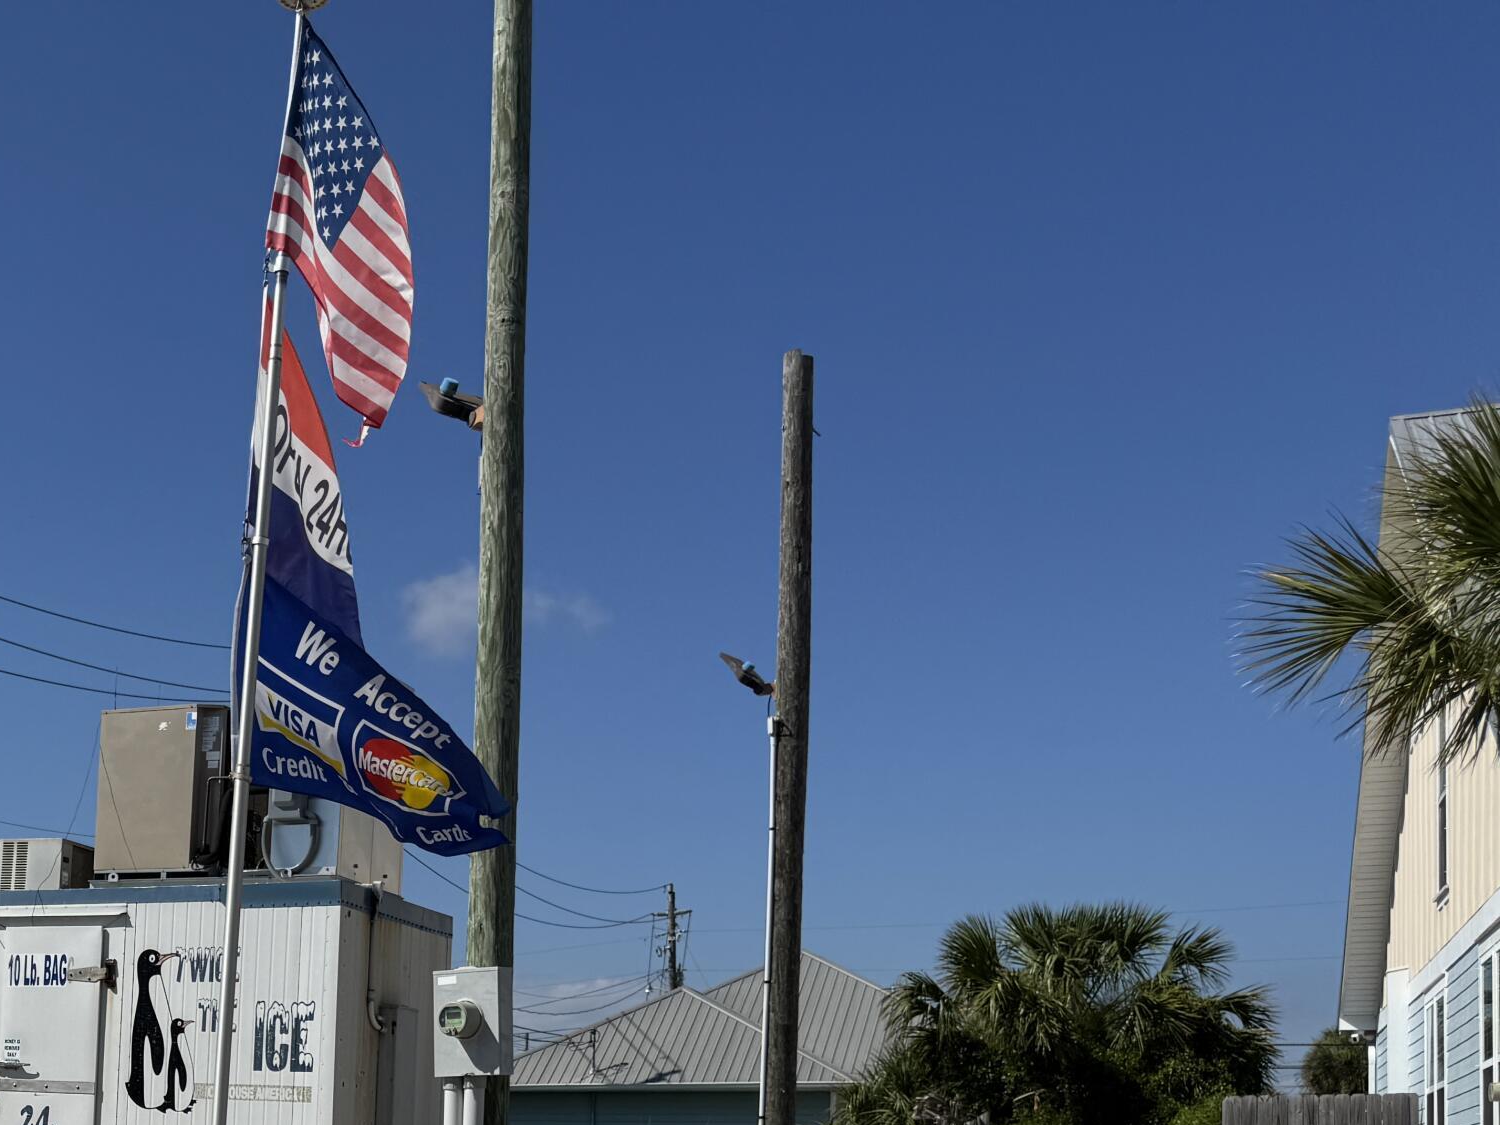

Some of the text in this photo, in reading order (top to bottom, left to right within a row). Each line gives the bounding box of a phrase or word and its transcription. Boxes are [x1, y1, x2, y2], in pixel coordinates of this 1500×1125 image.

[294, 620, 452, 750] We Accept
[267, 692, 321, 748] VISA
[262, 747, 329, 783] Credit
[8, 954, 68, 987] 10 Lb. BAG
